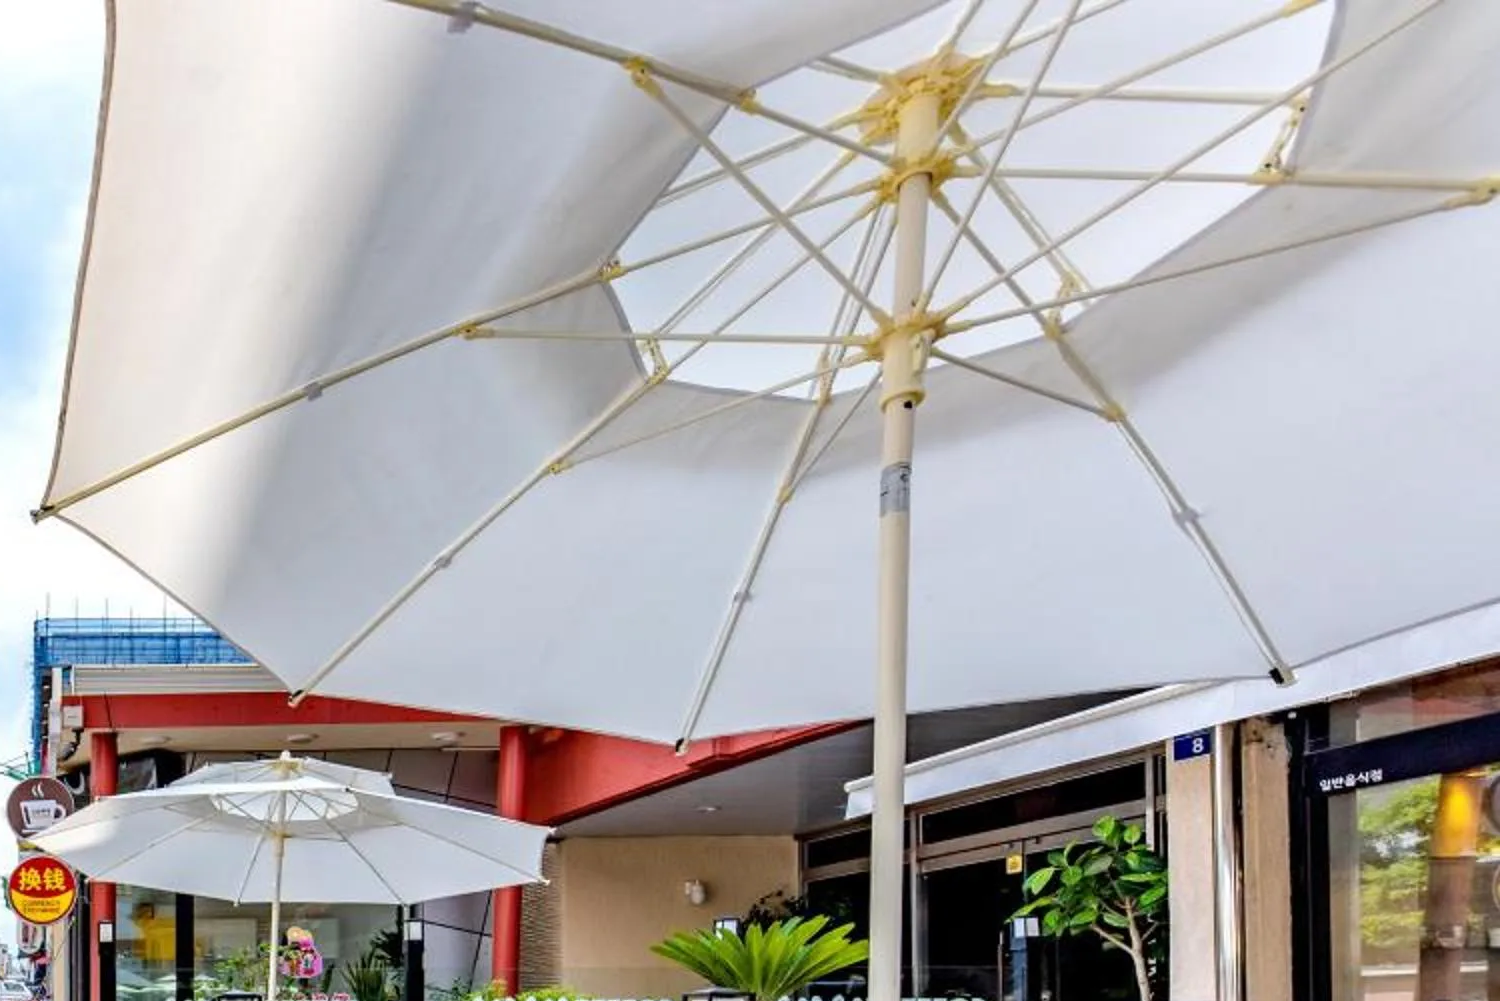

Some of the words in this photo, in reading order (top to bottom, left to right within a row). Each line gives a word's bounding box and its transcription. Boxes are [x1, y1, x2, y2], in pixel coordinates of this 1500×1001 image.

[1192, 737, 1204, 754] 8
[1319, 768, 1383, 793] 일반음식점
[18, 867, 67, 891] 换钱
